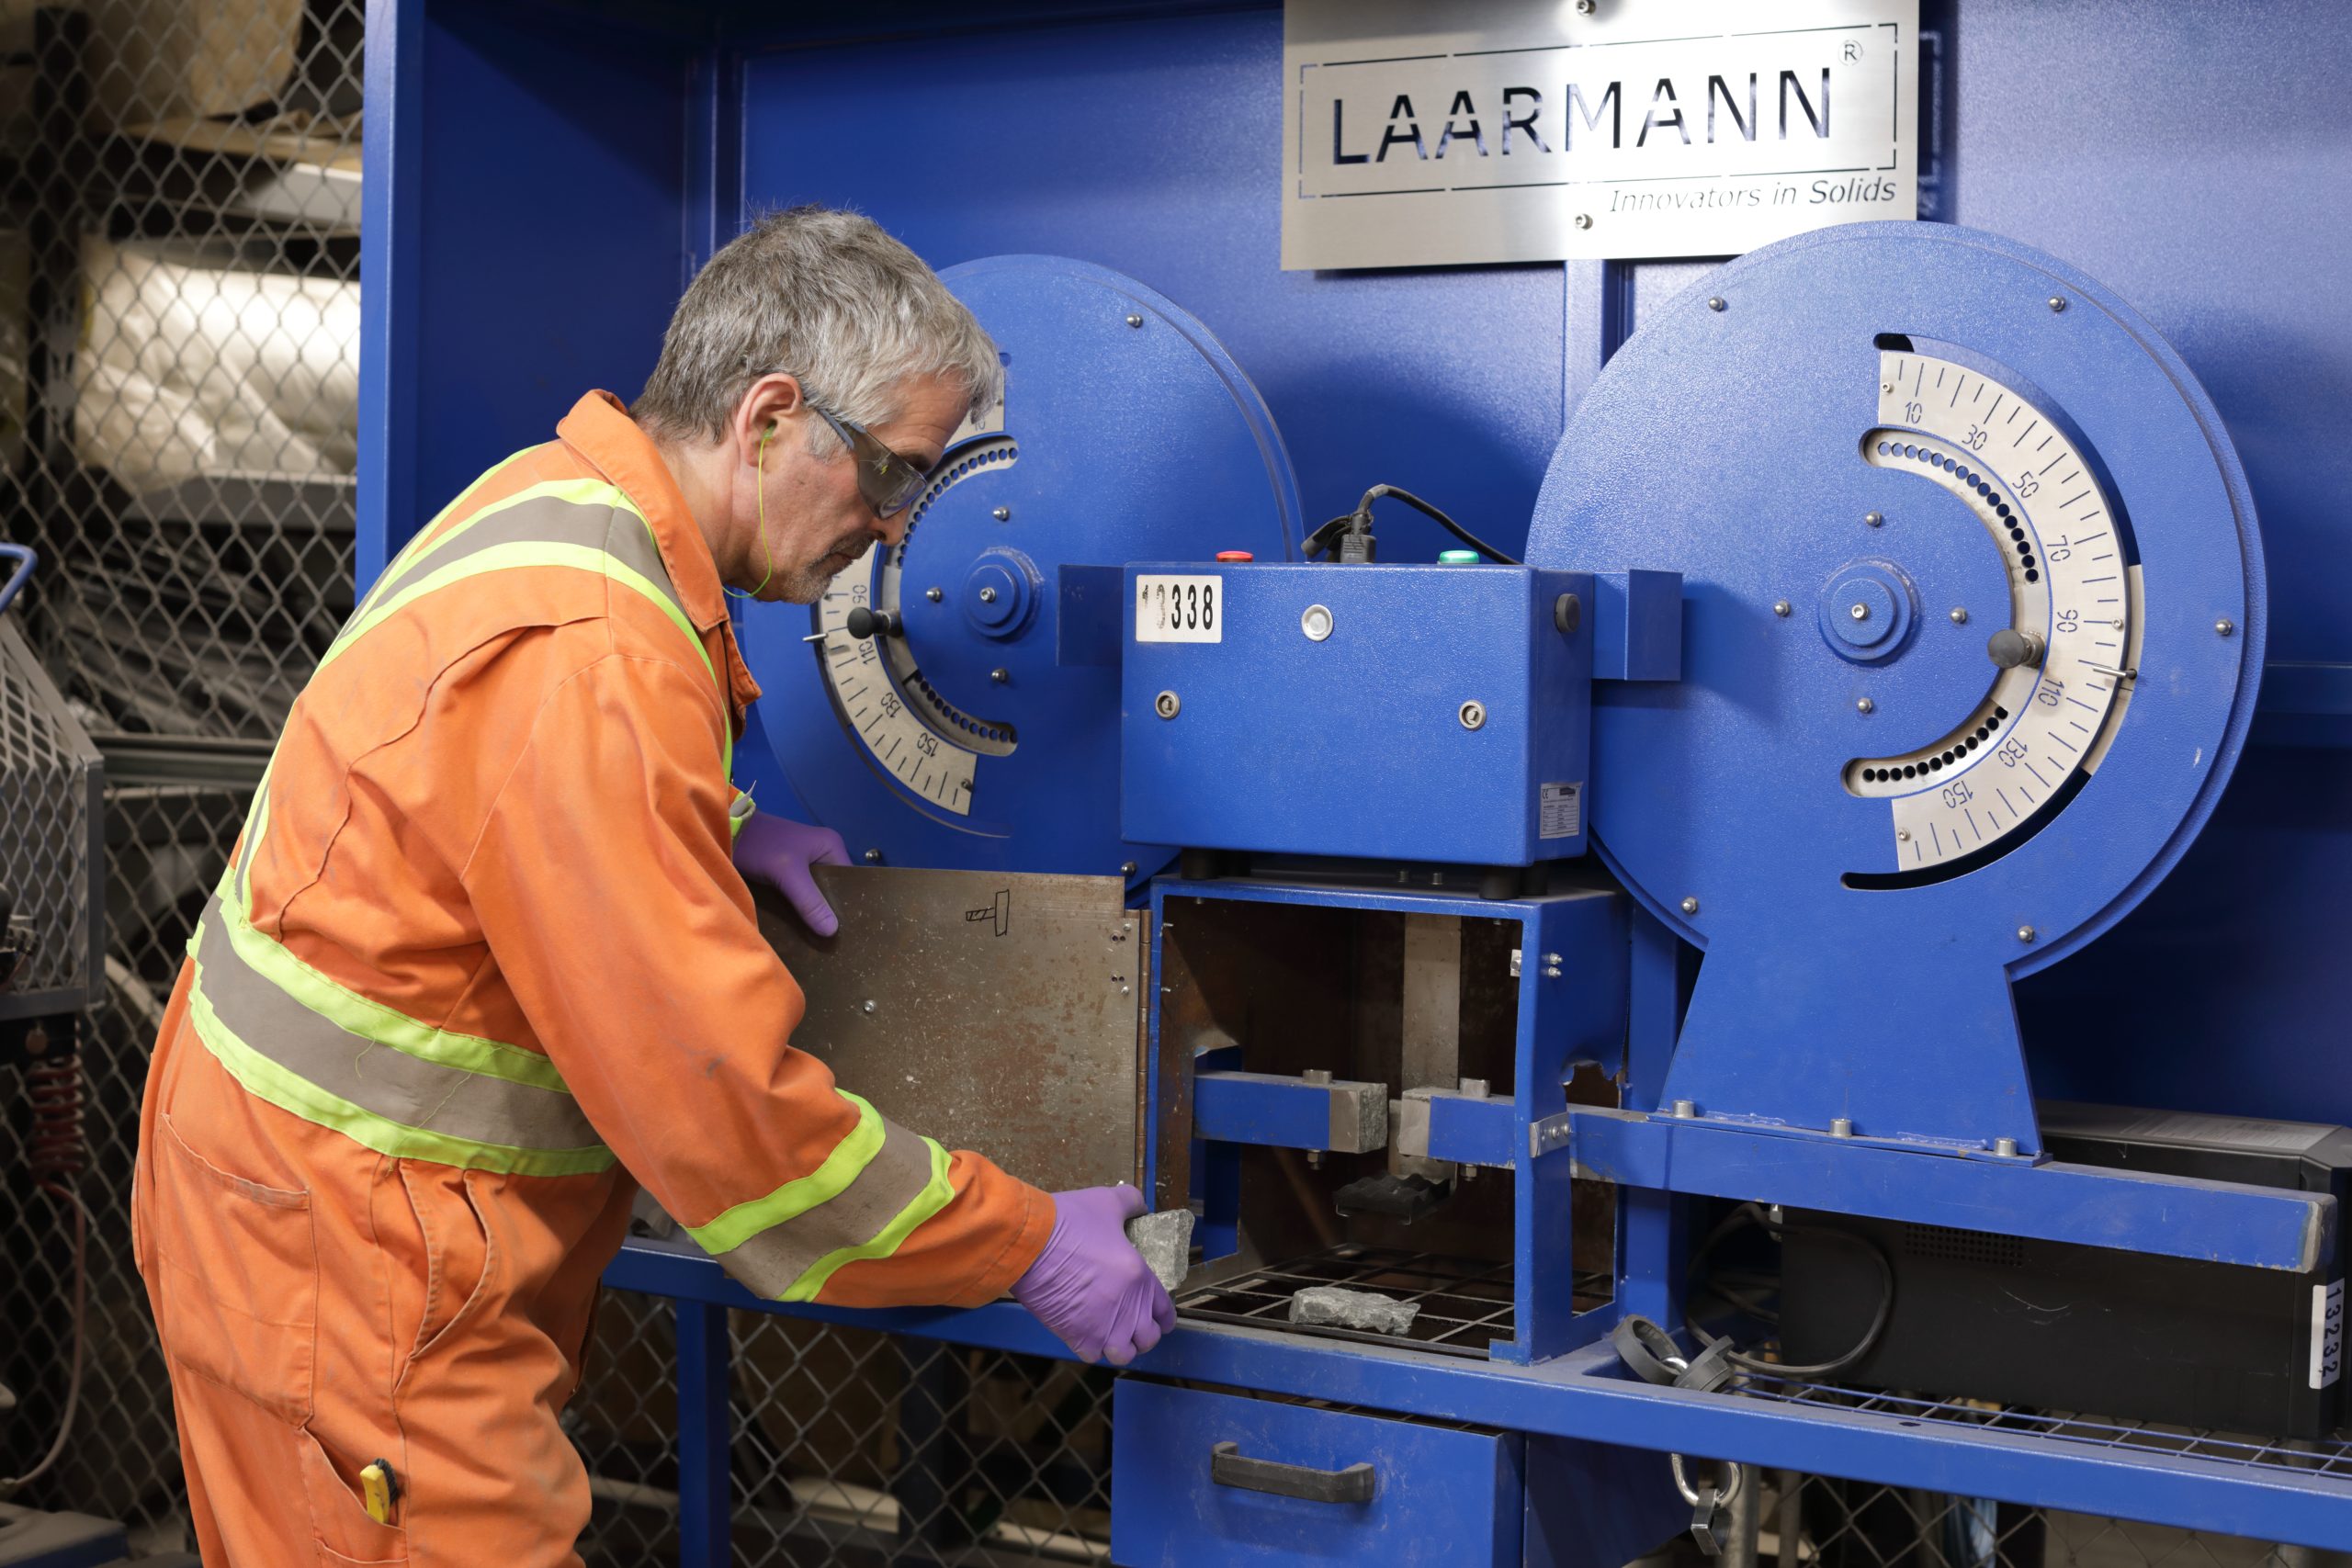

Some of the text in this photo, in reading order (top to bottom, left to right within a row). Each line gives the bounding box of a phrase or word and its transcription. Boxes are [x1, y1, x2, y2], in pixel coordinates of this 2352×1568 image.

[1332, 66, 1831, 165] LAARMANN
[1609, 175, 1896, 212] Innovators in Solids
[1905, 400, 1923, 424] 10
[1962, 423, 1988, 451] 30
[2011, 470, 2040, 499] 50
[2046, 535, 2071, 562] 70
[2056, 609, 2078, 633] 90
[880, 692, 902, 718] 130
[2038, 678, 2065, 707] 110
[917, 731, 939, 758] 150
[1997, 737, 2029, 768] 130
[1942, 780, 1973, 809] 150
[2322, 1286, 2343, 1378] 13232
